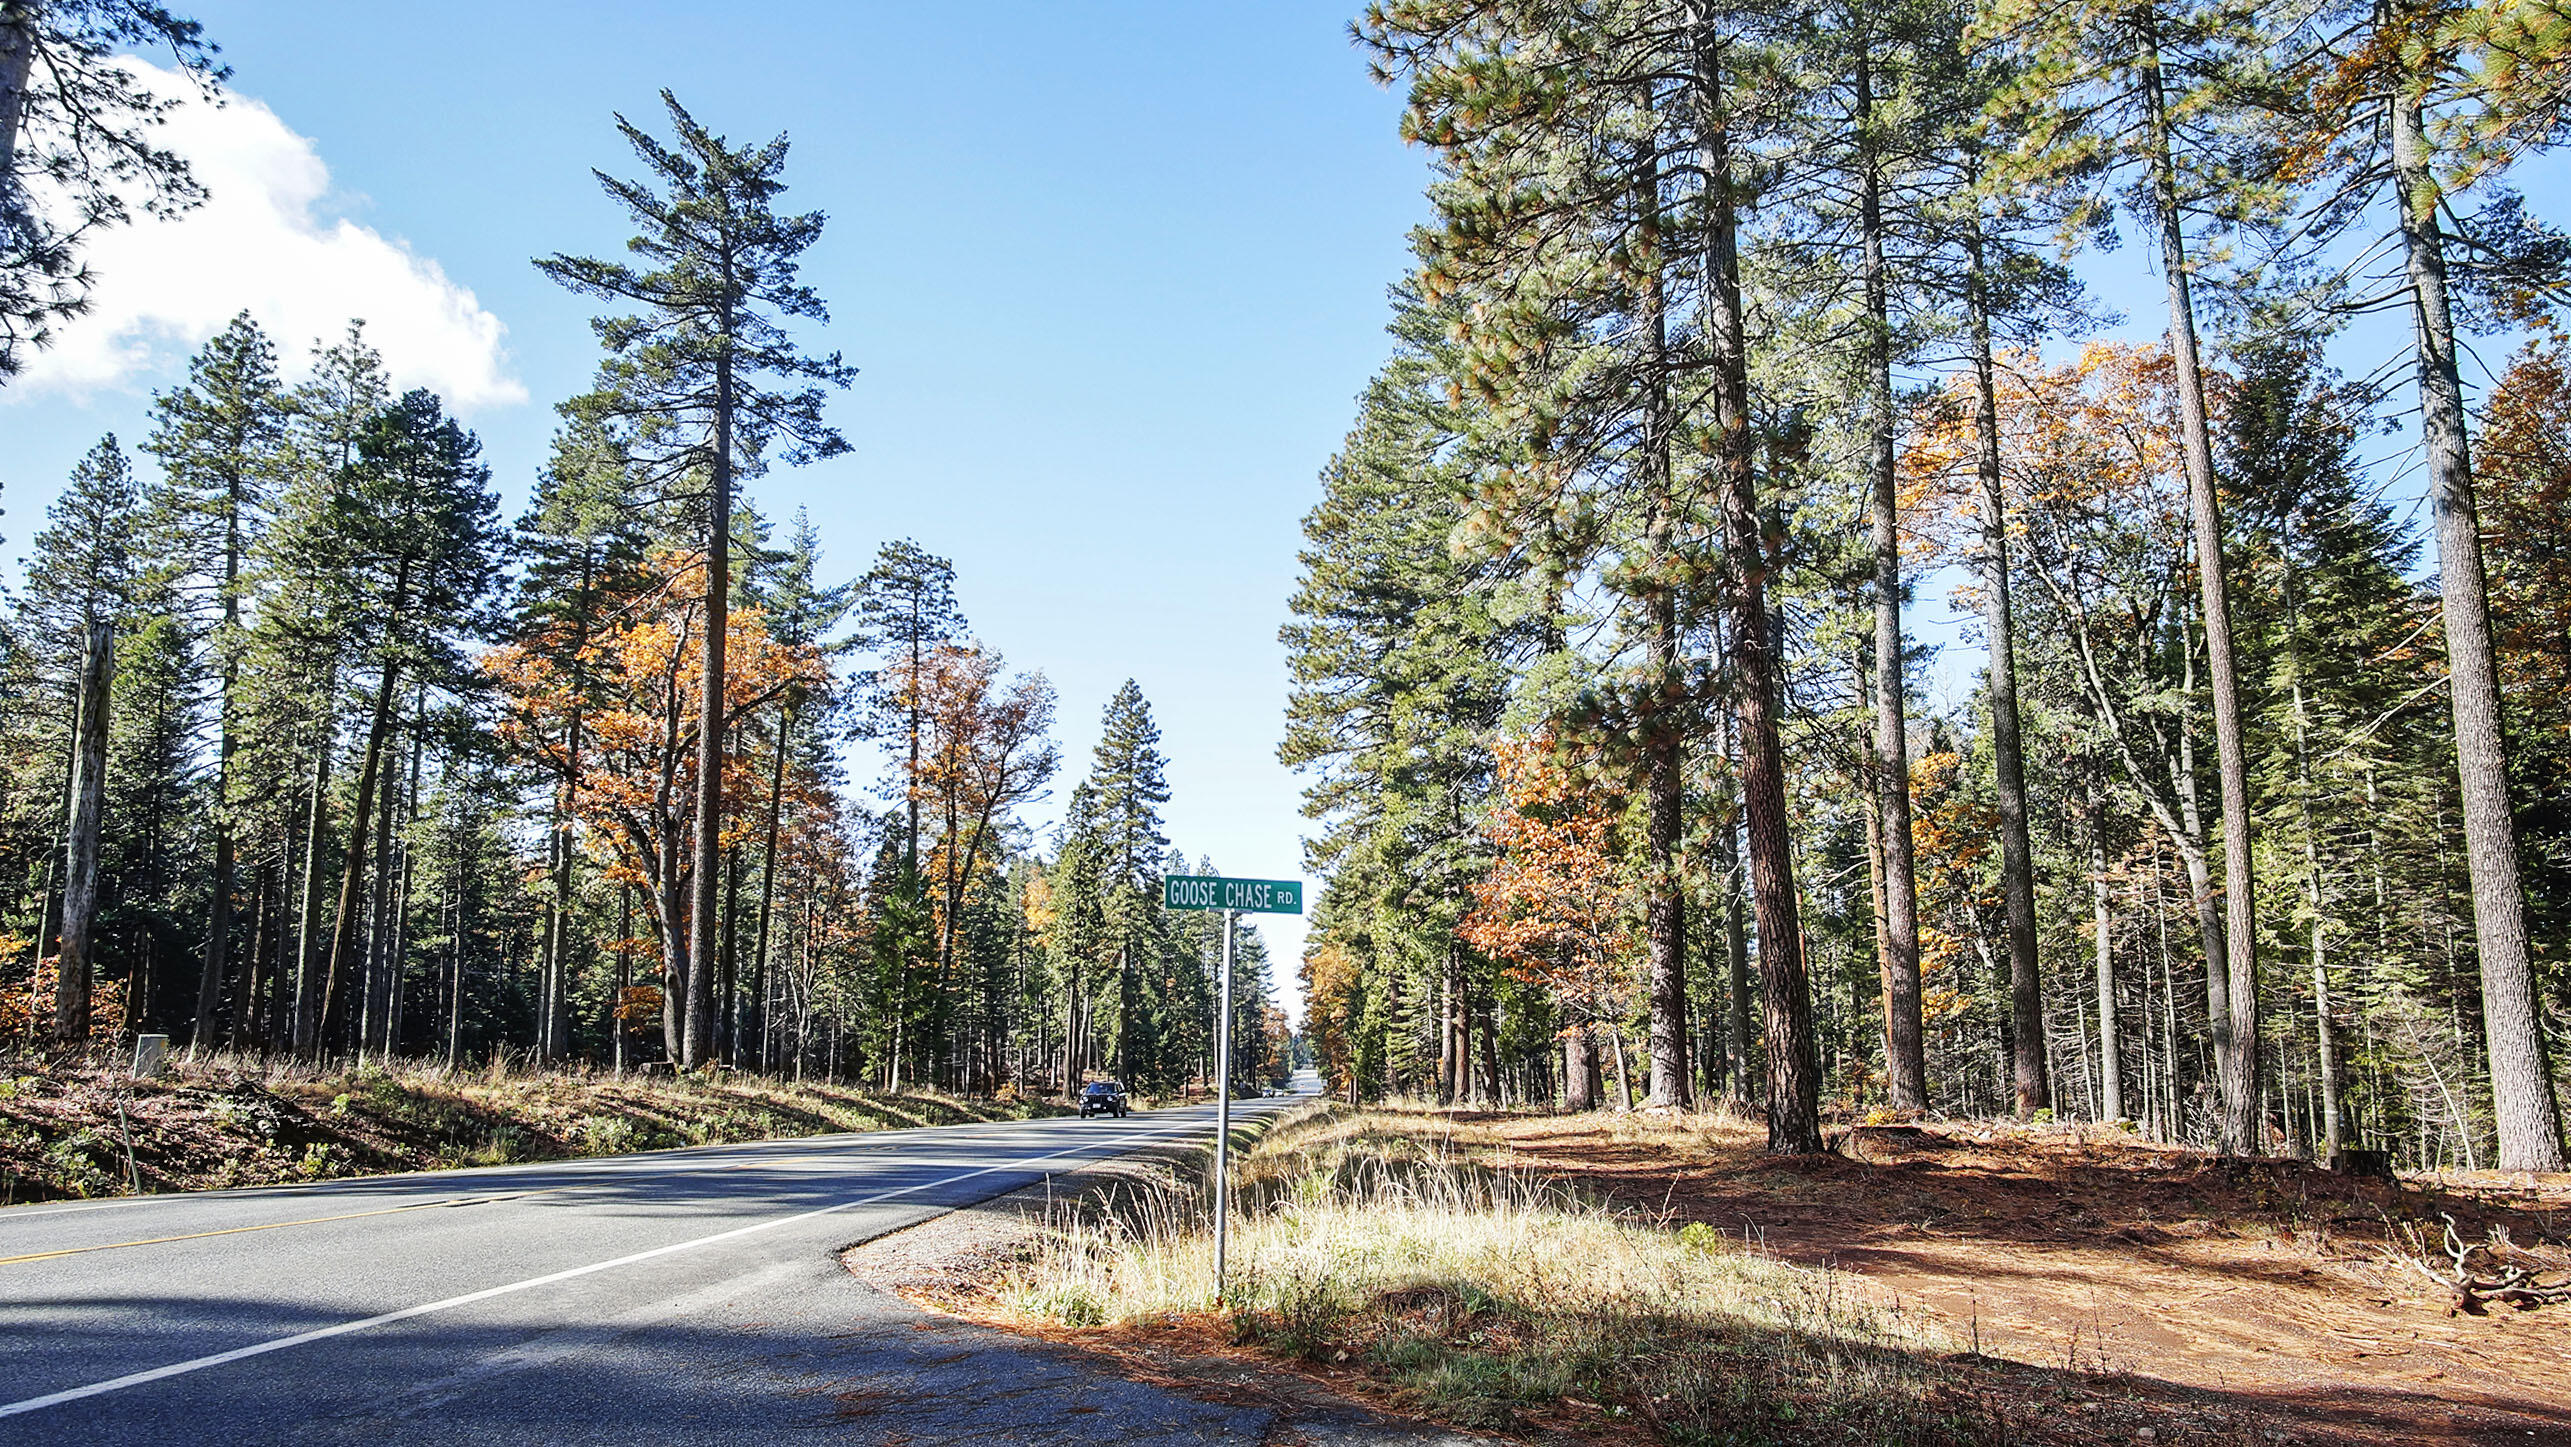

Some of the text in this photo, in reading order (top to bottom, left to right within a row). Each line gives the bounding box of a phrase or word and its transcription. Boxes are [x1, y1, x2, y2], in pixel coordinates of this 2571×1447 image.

[1170, 880, 1297, 908] GOOSE CHASE RD.
